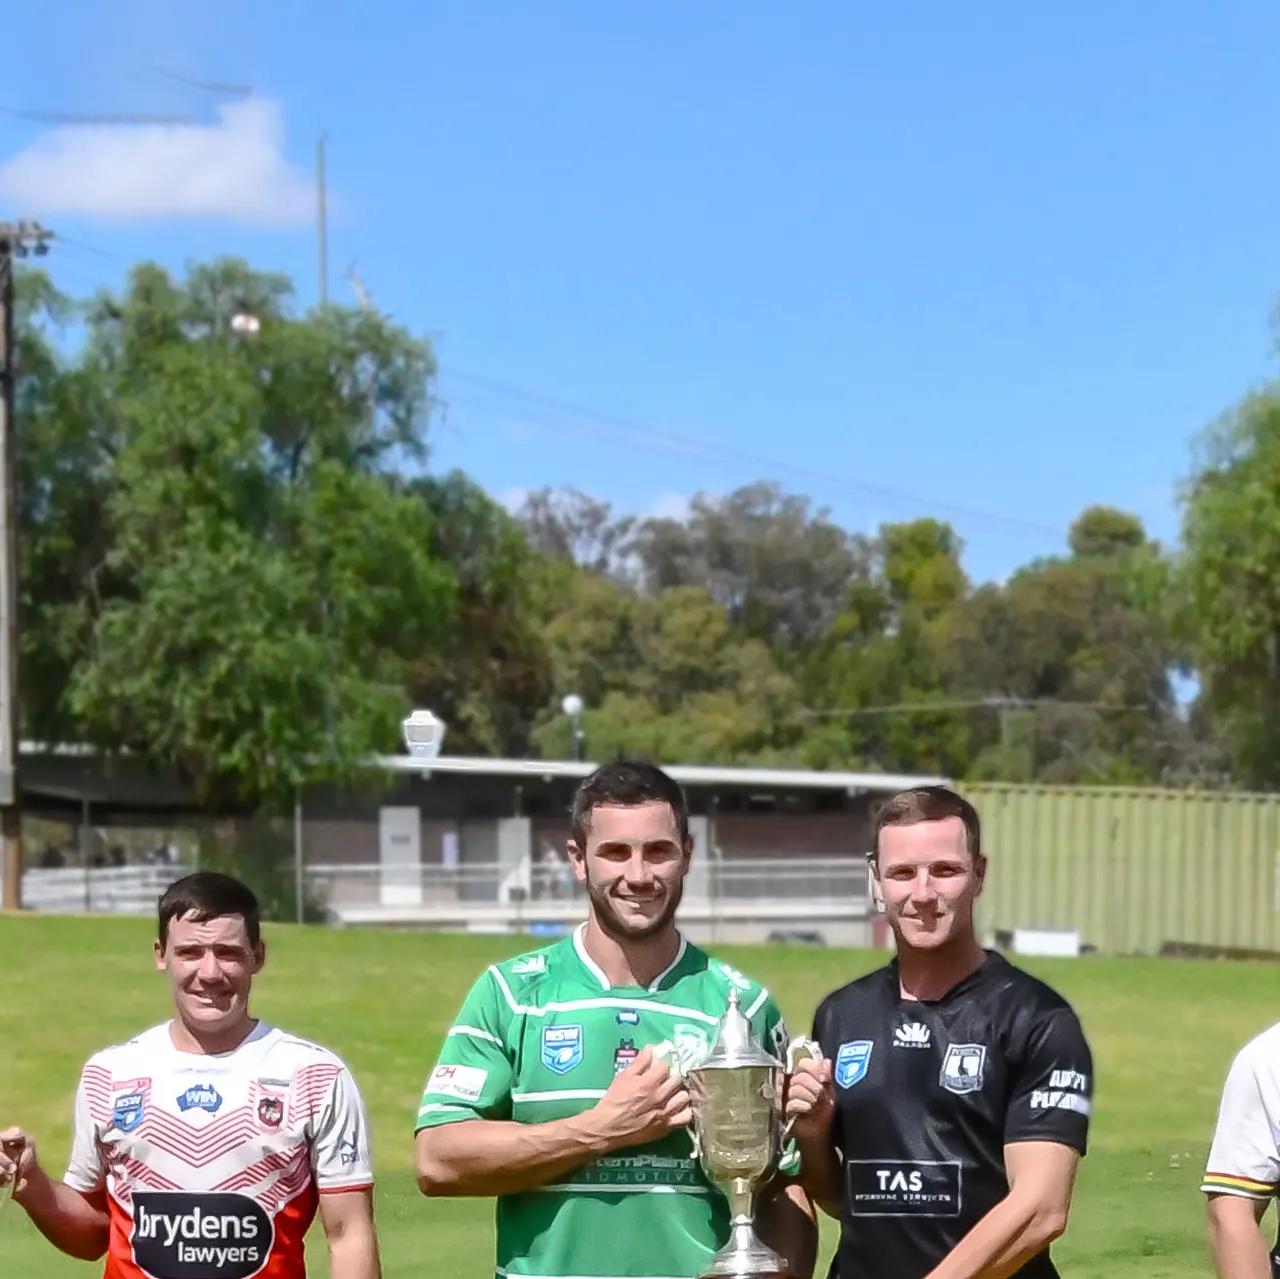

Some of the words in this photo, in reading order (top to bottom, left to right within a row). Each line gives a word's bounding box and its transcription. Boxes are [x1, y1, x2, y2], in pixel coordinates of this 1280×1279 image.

[875, 1169, 924, 1192] TAS
[138, 1206, 259, 1247] brydens
[178, 1241, 260, 1268] lawyers
